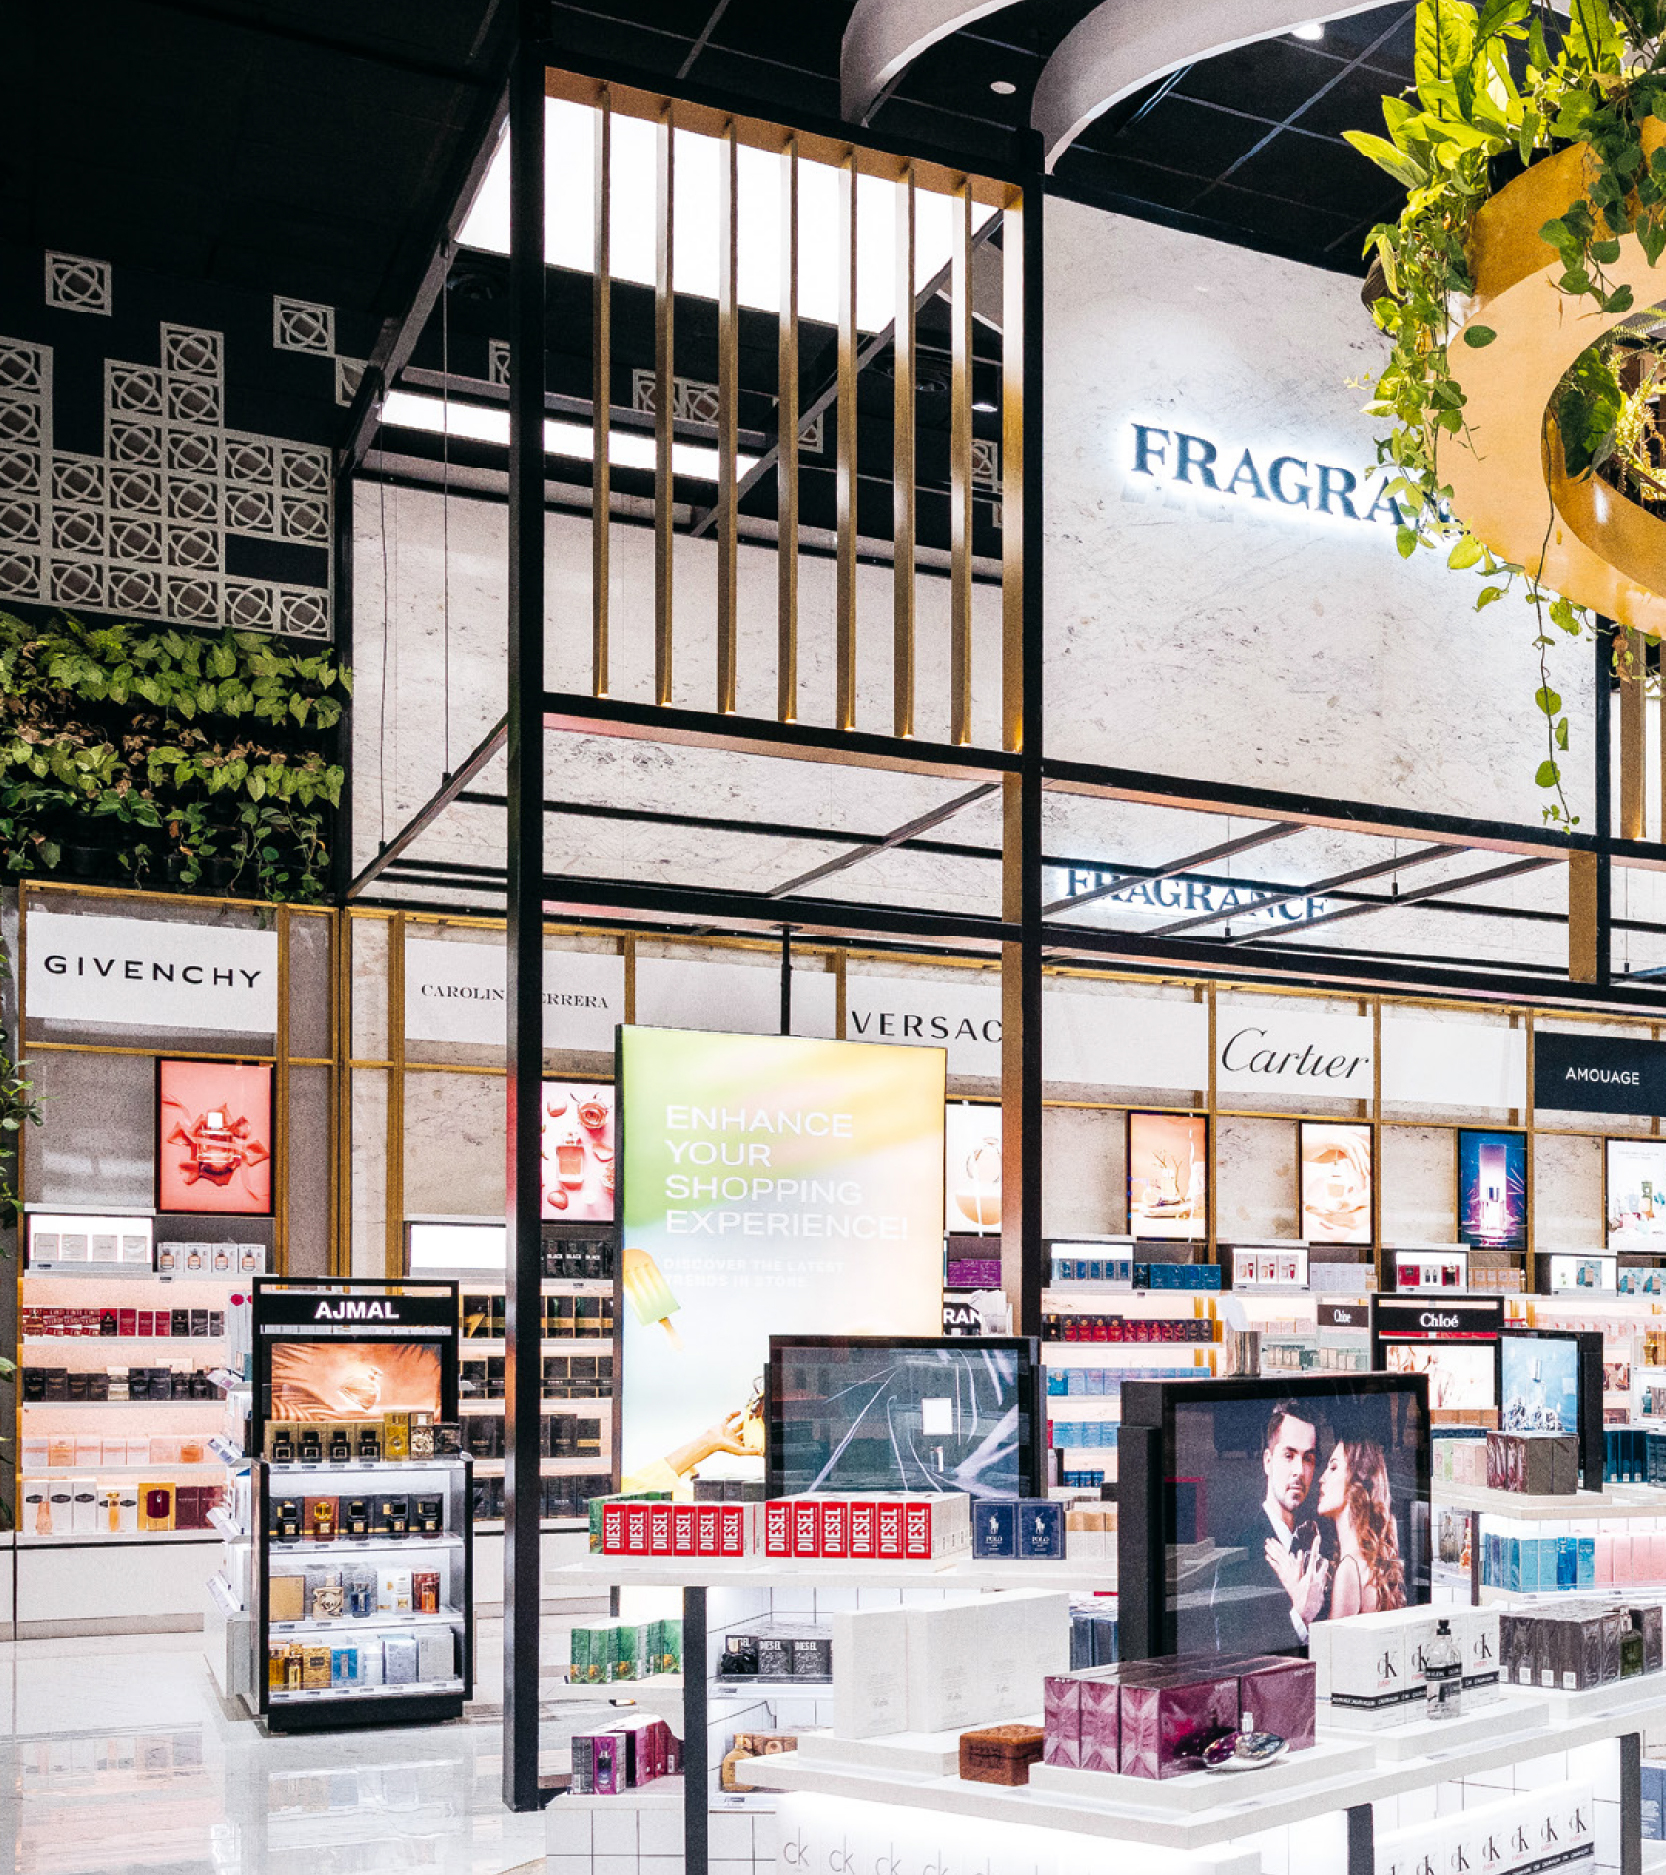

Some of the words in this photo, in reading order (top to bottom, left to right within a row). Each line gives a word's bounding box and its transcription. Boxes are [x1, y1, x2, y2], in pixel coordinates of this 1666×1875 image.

[1130, 422, 1432, 532] FRAGRA
[43, 954, 263, 989] GIVENCHY
[421, 984, 505, 1001] CAROLIN
[542, 993, 609, 1009] ERRERA
[851, 1010, 1002, 1043] VERSAC
[1221, 1027, 1370, 1079] Cartier
[1565, 1066, 1640, 1086] AMOUAGE
[666, 1105, 853, 1138] ENHANCE
[664, 1140, 772, 1167] YOUR
[665, 1174, 862, 1206] SHOPPING
[666, 1210, 908, 1241] EXPERIENCE!
[315, 1301, 400, 1320] AJMAL
[943, 1308, 982, 1324] RAN
[1420, 1312, 1458, 1328] Chloé
[606, 1511, 620, 1549] DIESEL
[629, 1511, 644, 1549] DIESEL
[653, 1511, 667, 1549] DIESEL
[676, 1512, 691, 1550] DIESEL
[700, 1512, 714, 1550] DIESEL
[724, 1512, 738, 1550] DIESEL
[768, 1507, 785, 1551] DIESEL
[797, 1507, 814, 1551] DIESEL
[825, 1507, 841, 1552] DIESEL
[853, 1508, 870, 1552] DIESEL
[880, 1508, 897, 1552] DIESEL
[908, 1508, 925, 1553] DIESEL
[783, 1826, 809, 1866] ck
